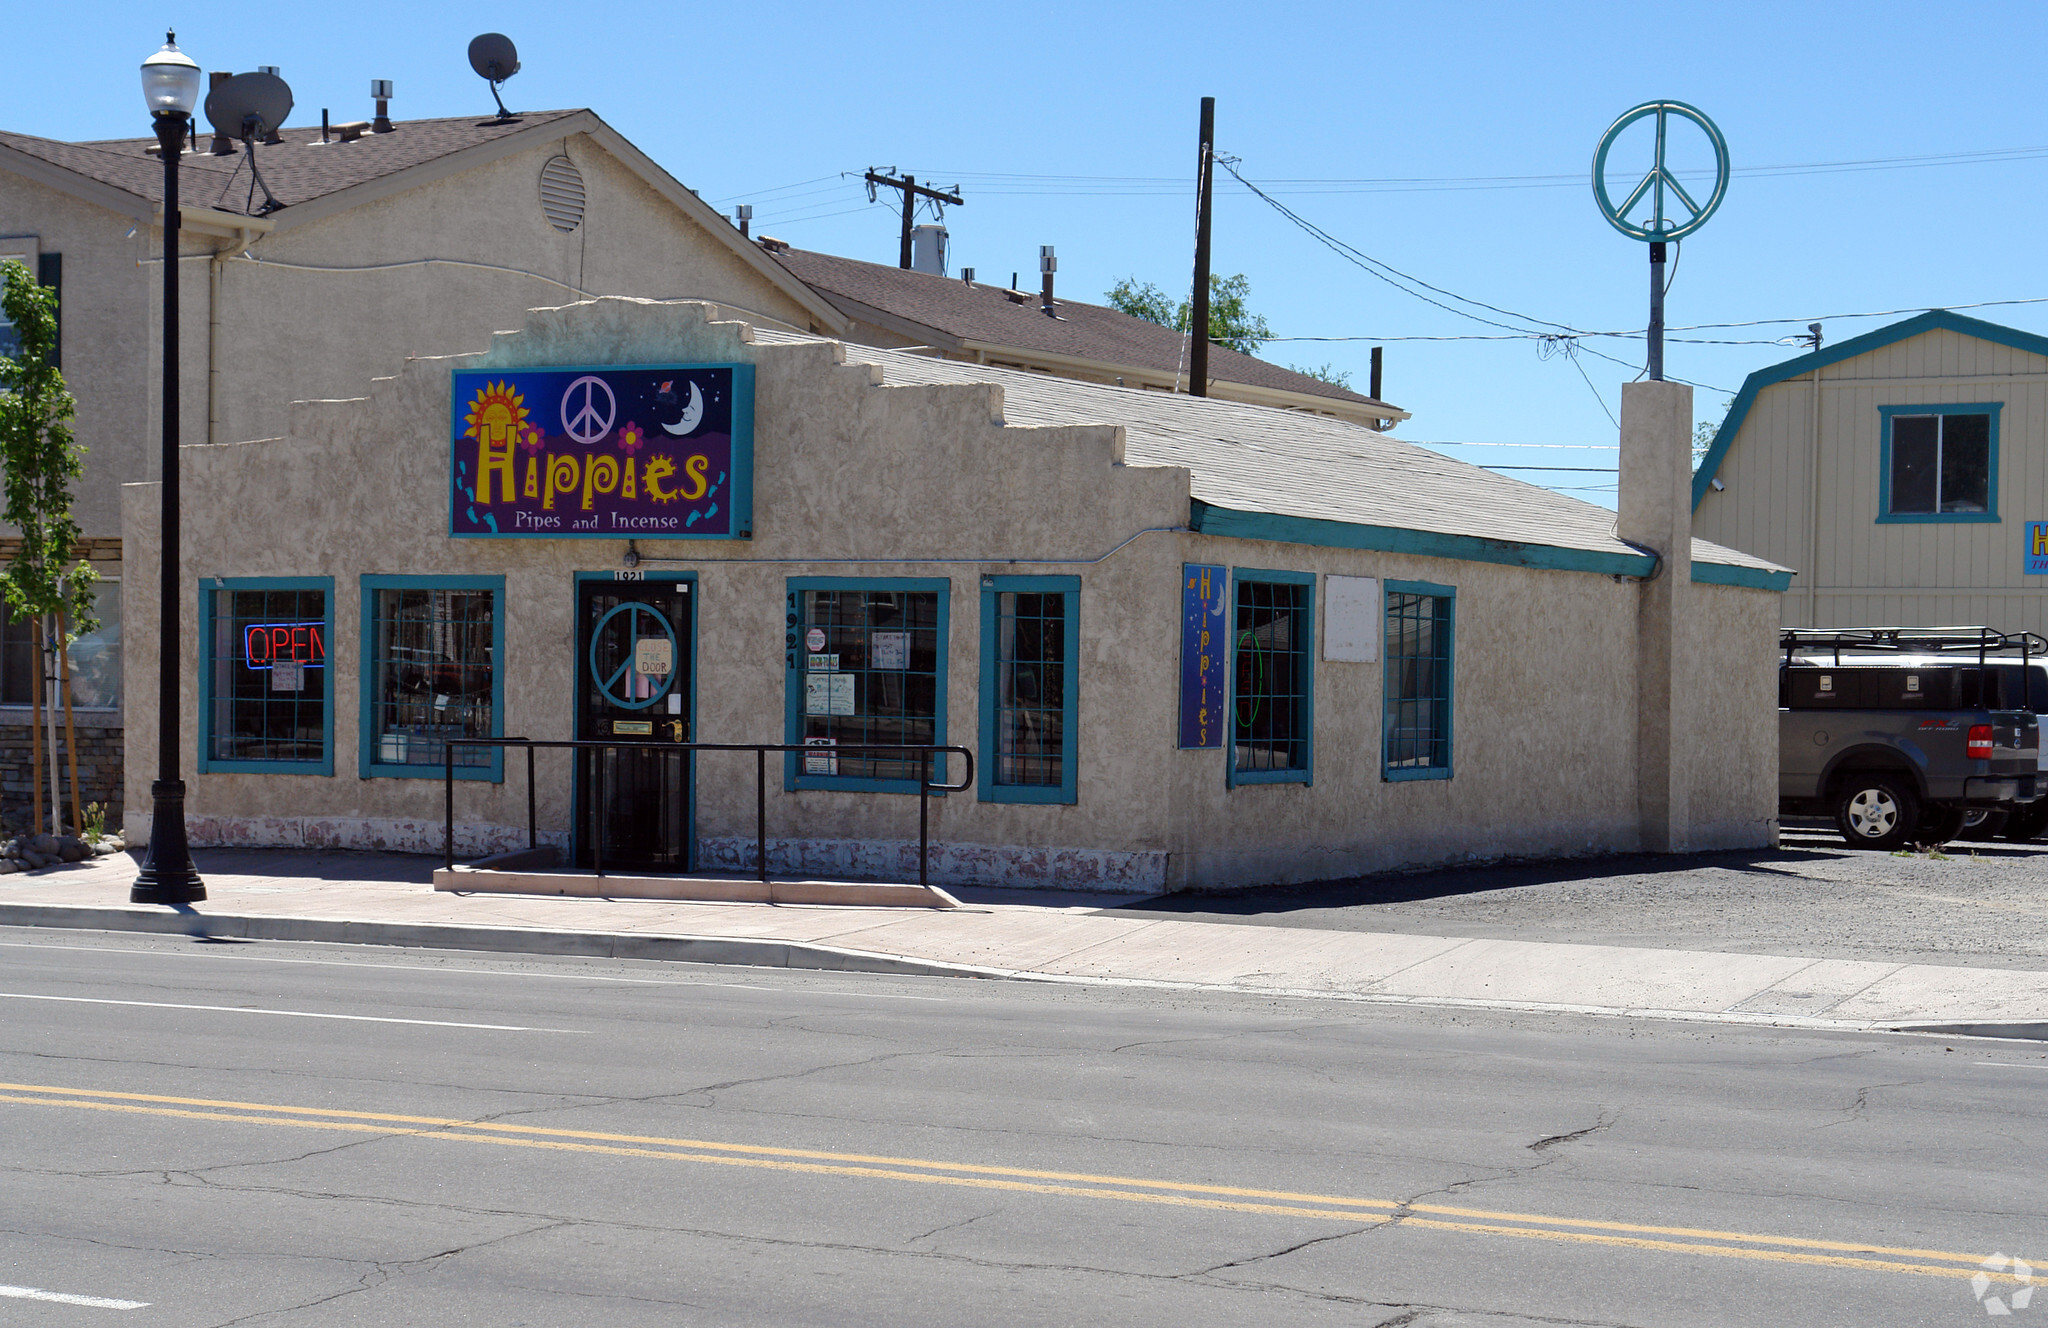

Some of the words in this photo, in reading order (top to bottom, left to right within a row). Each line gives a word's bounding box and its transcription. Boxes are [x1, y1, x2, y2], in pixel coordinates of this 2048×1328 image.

[475, 423, 710, 510] Hippies
[515, 511, 561, 530] Pipes
[572, 514, 599, 529] and
[611, 511, 678, 529] Incense
[616, 571, 642, 581] 1921
[786, 592, 798, 669] 1921
[248, 627, 325, 663] OPEN
[643, 653, 661, 661] THE
[1199, 567, 1211, 746] Hippies
[642, 662, 667, 672] DOOR
